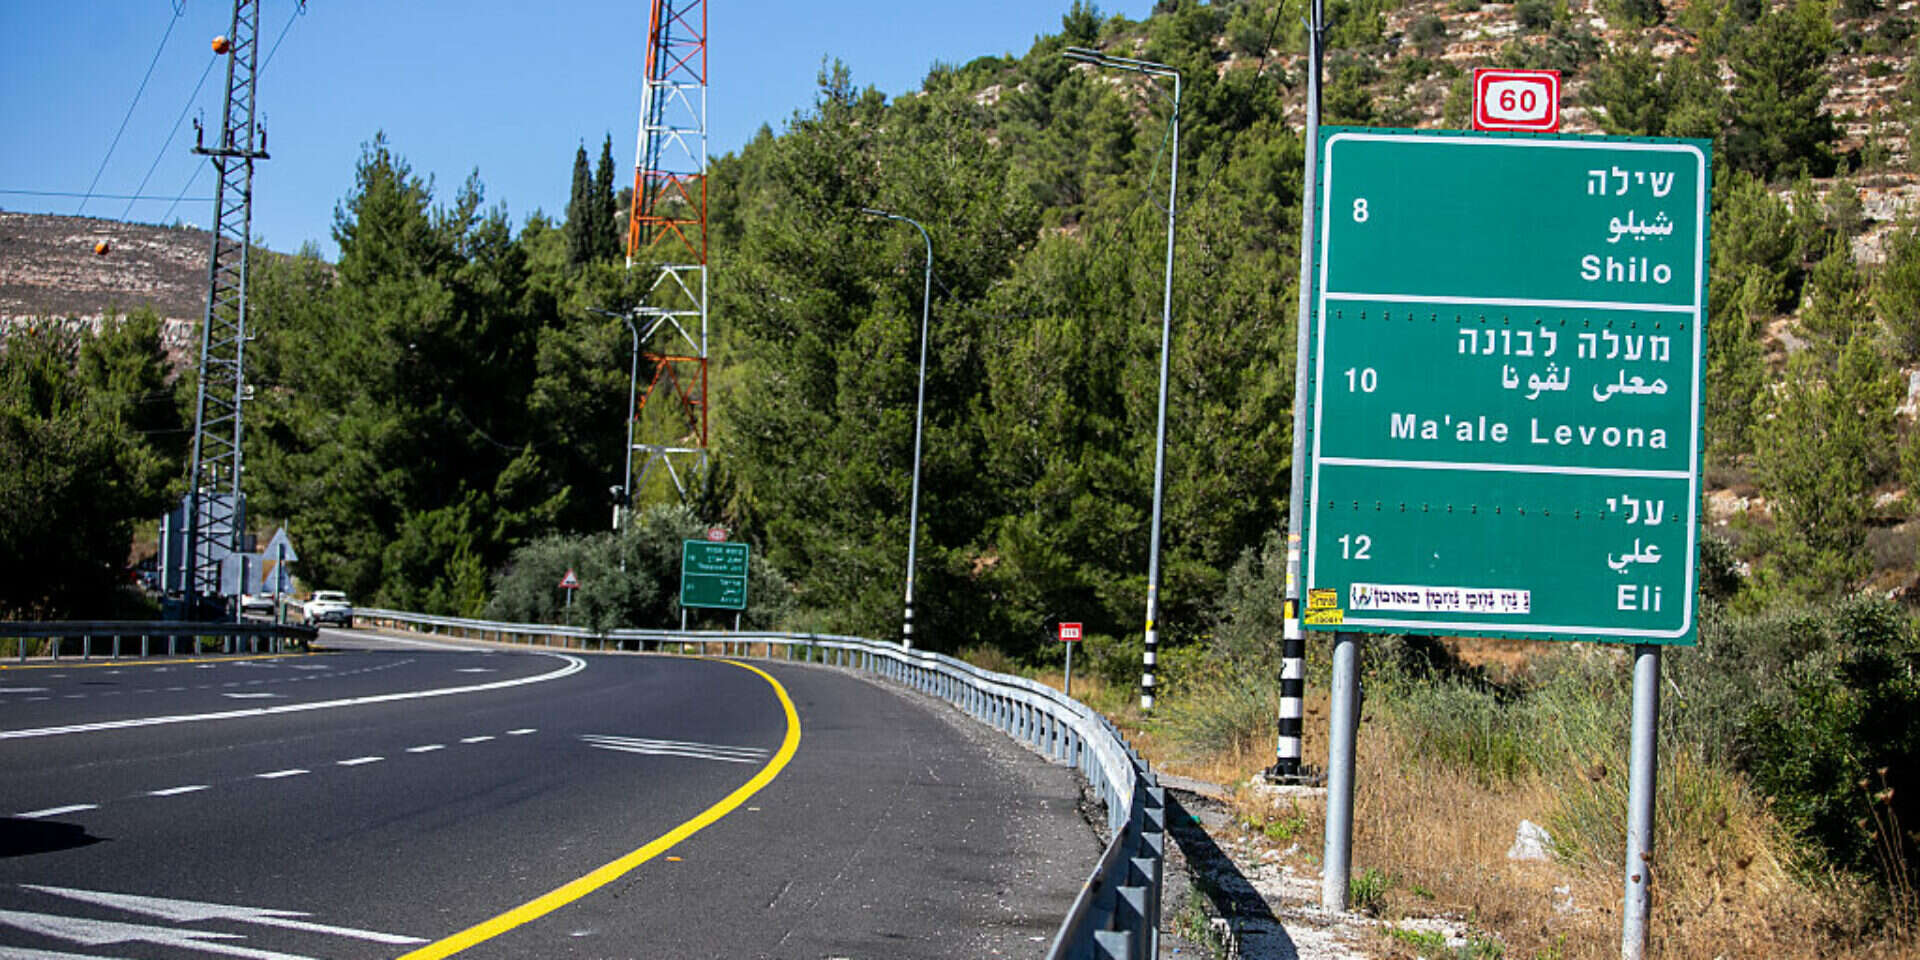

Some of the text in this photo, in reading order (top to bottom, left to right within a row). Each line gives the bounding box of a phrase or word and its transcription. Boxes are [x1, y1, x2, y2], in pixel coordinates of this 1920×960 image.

[1499, 89, 1537, 113] 60
[1588, 166, 1675, 198] שילה
[1353, 198, 1369, 223] 8
[1606, 210, 1673, 243] شيلو
[1580, 254, 1672, 284] Shilo
[1458, 326, 1670, 362] מעלה לבונה
[1345, 367, 1377, 393] 10
[1593, 369, 1668, 402] معلى
[1390, 413, 1666, 449] Ma'ale Levona
[1606, 494, 1664, 526] עלי
[1338, 534, 1372, 560] 12
[1607, 537, 1662, 574] علي
[1617, 584, 1662, 612] Eli
